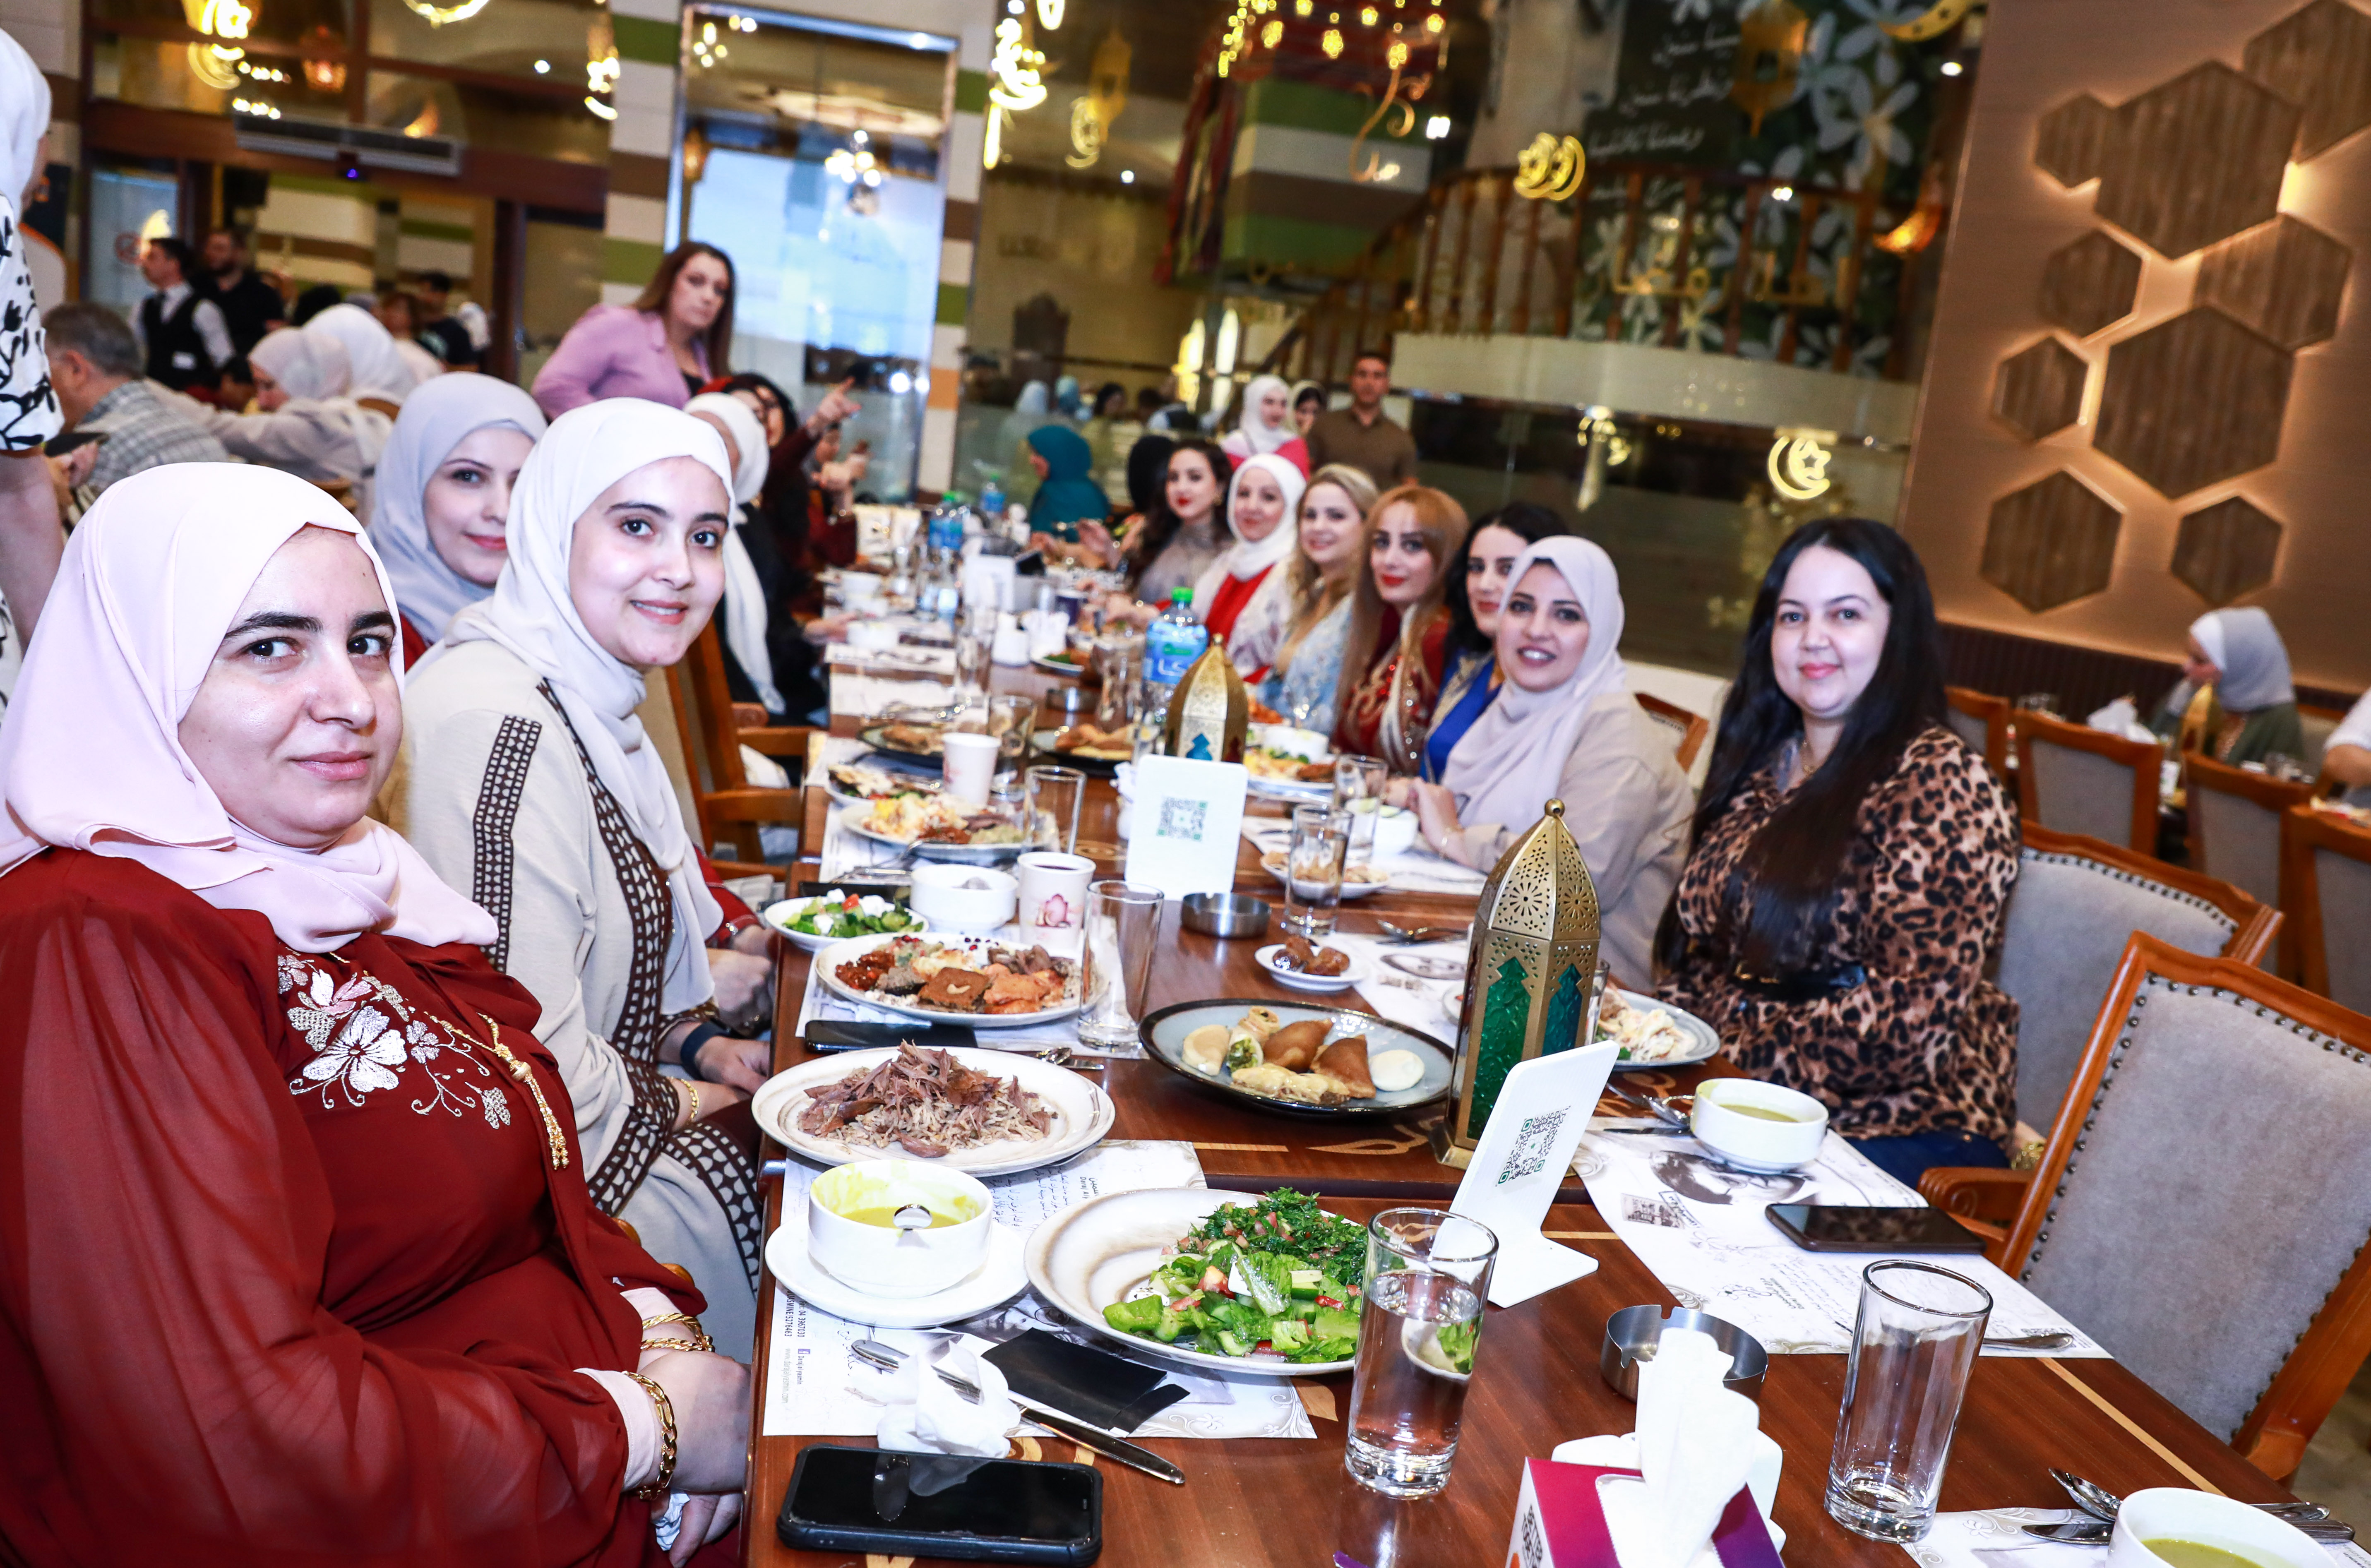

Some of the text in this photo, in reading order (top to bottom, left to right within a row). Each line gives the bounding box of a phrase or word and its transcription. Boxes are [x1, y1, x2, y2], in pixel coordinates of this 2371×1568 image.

[797, 1317, 806, 1337] 3967030
[781, 1348, 793, 1404] www.darajalyasmin.com
[795, 1370, 804, 1385] yasmin
